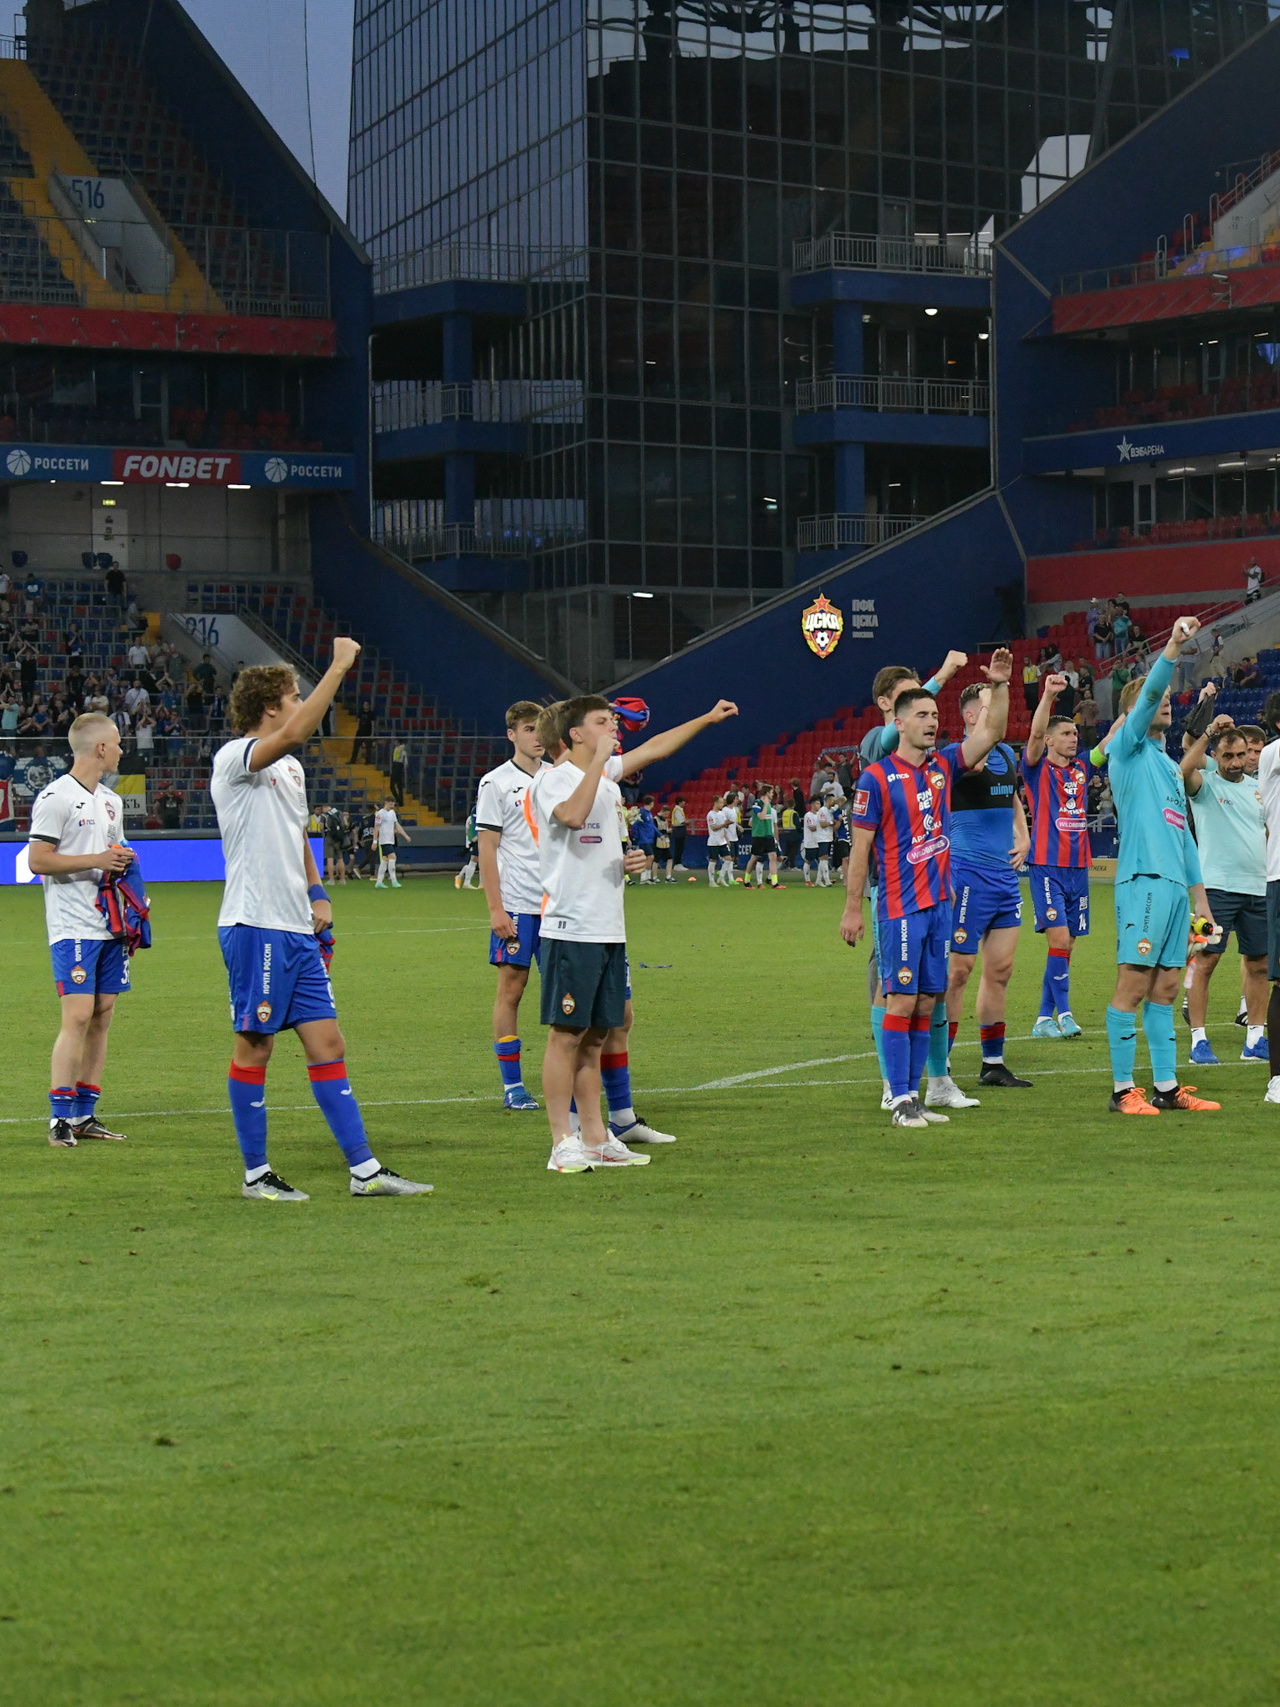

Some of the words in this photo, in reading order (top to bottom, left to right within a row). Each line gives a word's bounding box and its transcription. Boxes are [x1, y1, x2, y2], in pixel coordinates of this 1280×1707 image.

[71, 179, 105, 209] 516
[34, 457, 89, 471] РОССЕТИ
[123, 455, 231, 479] FONBET
[290, 464, 342, 478] РОССЕТИ
[852, 599, 875, 612] ПФК
[805, 613, 841, 632] ЦСКА
[852, 615, 879, 629] ЦСКА
[264, 943, 272, 974] РОССИИ
